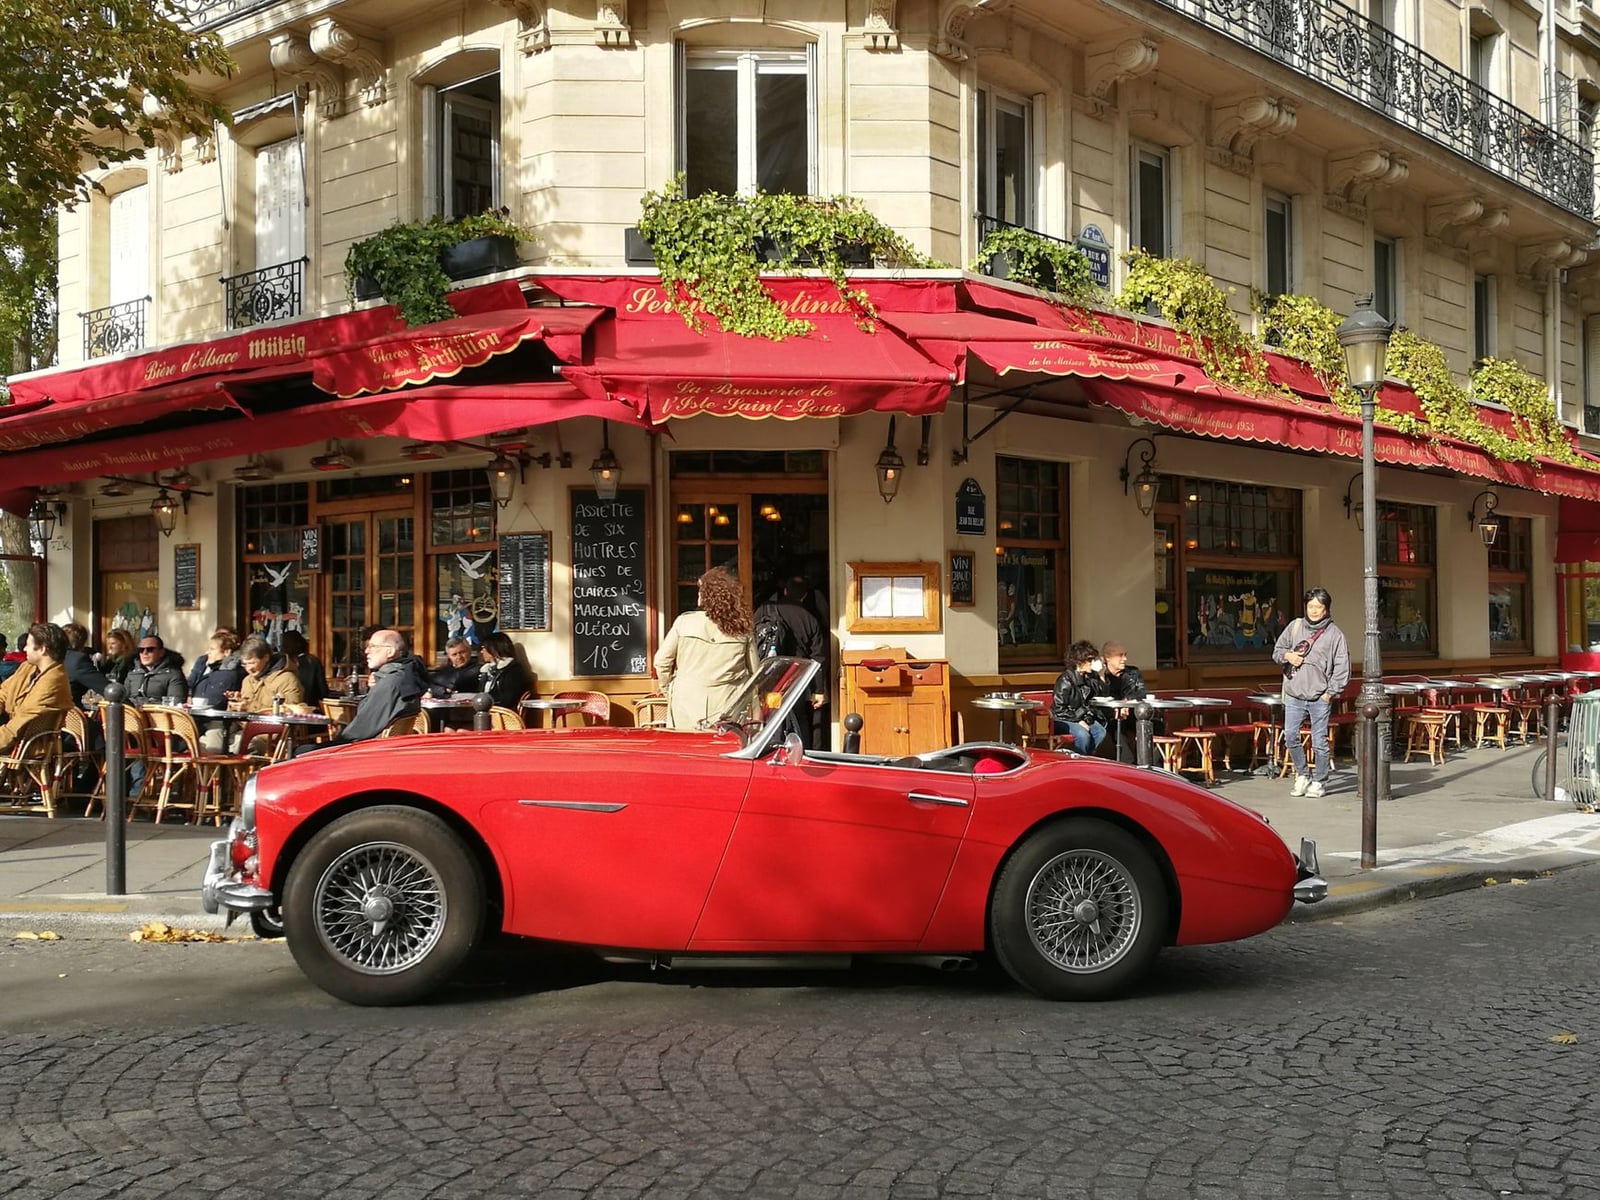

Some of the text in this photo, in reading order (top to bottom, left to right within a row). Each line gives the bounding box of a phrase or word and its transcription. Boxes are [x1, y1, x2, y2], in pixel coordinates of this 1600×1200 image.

[144, 360, 176, 380] Bière
[181, 347, 240, 372] d'Alsace
[369, 348, 409, 364] Glaces
[676, 381, 835, 397] La Brasserie de
[575, 503, 633, 518] ASSIETTE
[575, 524, 625, 537] DE SIX
[952, 557, 969, 570] VIN
[573, 564, 633, 579] FINES DE
[574, 586, 618, 599] CLAIRES
[575, 618, 631, 636] OLÉRON
